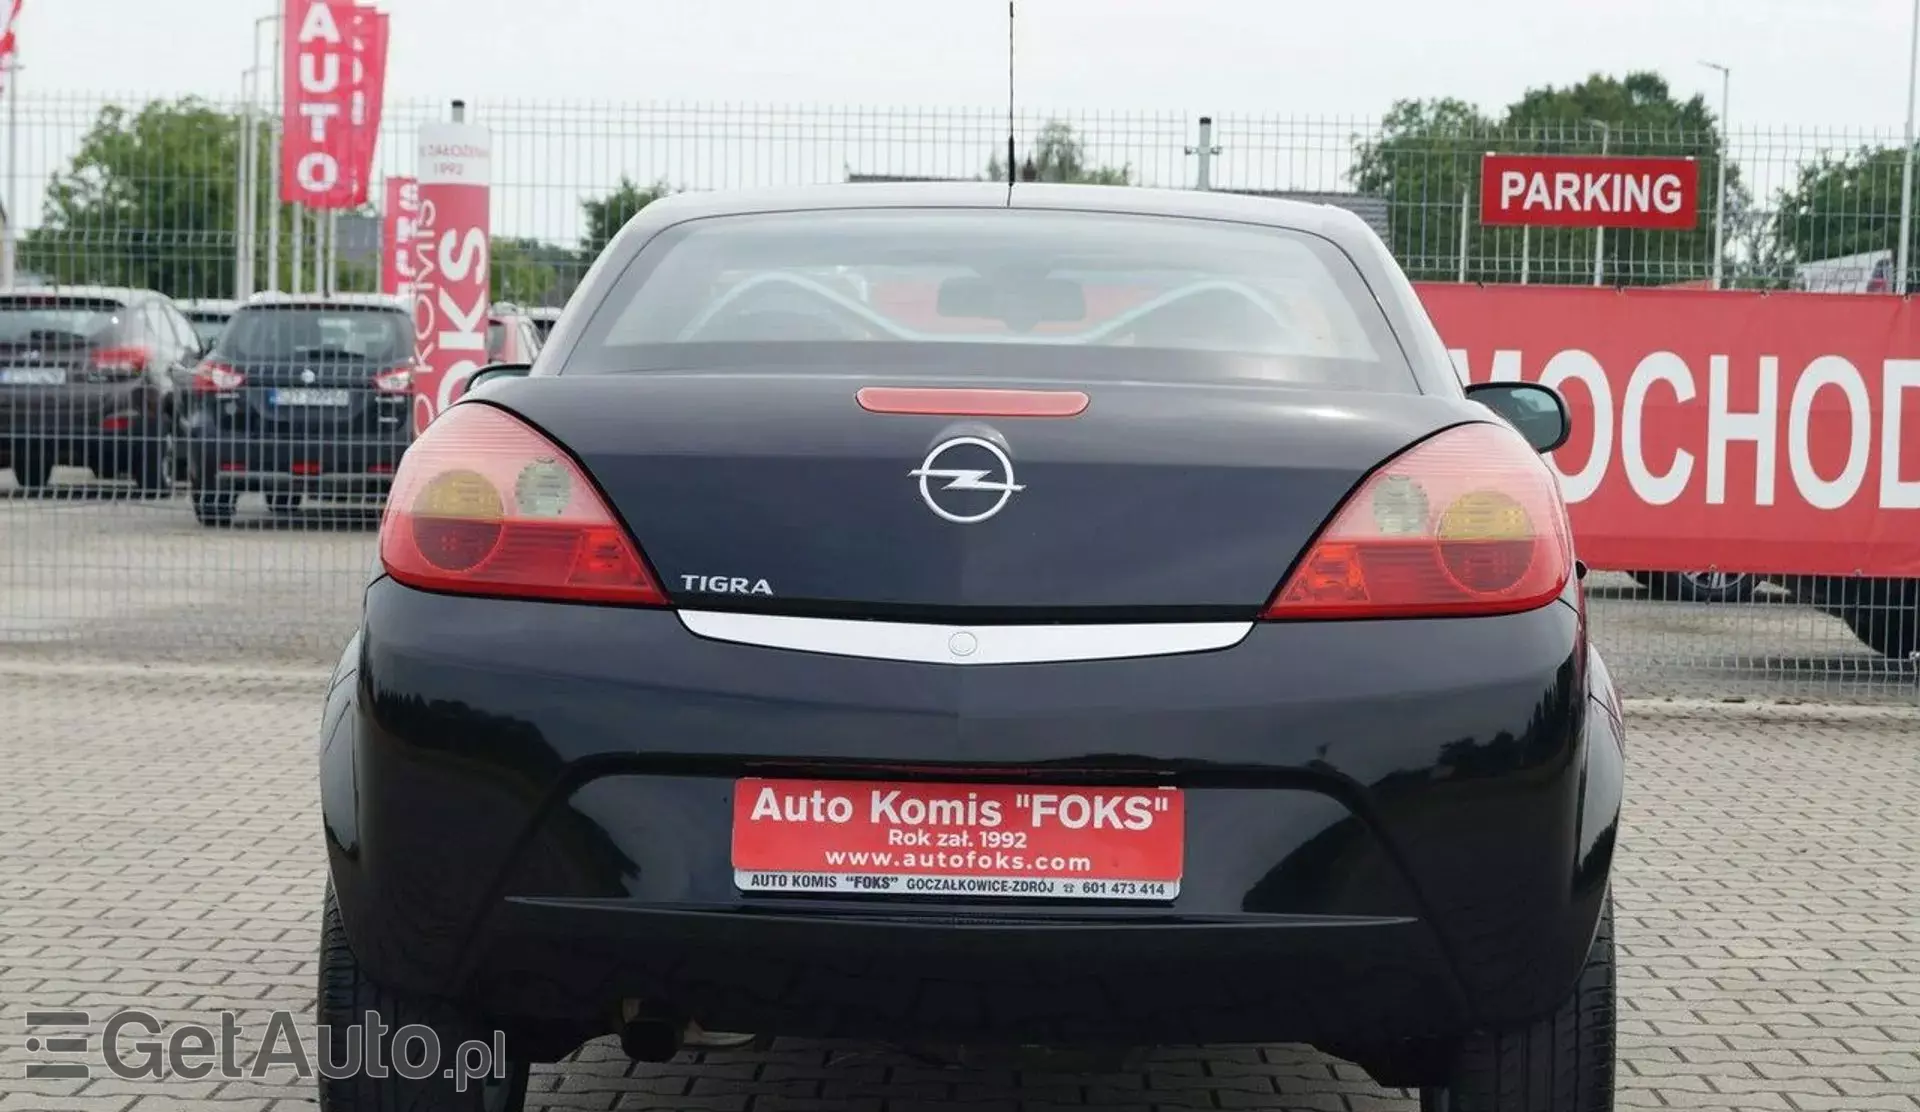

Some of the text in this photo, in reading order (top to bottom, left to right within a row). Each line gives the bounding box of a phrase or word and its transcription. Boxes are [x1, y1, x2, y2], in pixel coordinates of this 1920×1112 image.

[297, 2, 341, 192] AUTO
[1501, 171, 1682, 214] PARKING
[414, 199, 437, 373] KOMIS
[681, 574, 774, 596] TIGRA
[751, 787, 1169, 830] Auto Komis "FOKS"
[888, 829, 1027, 848] Rok zał. 1992
[825, 850, 1091, 872] www.autofoks.com
[751, 874, 788, 888] AUTO
[791, 875, 838, 889] KOMIS
[906, 876, 1055, 894] GOCZAŁKOWICE-ZDRÓJ
[1082, 882, 1107, 894] 601
[1111, 883, 1136, 895] 473
[1140, 884, 1166, 896] 414
